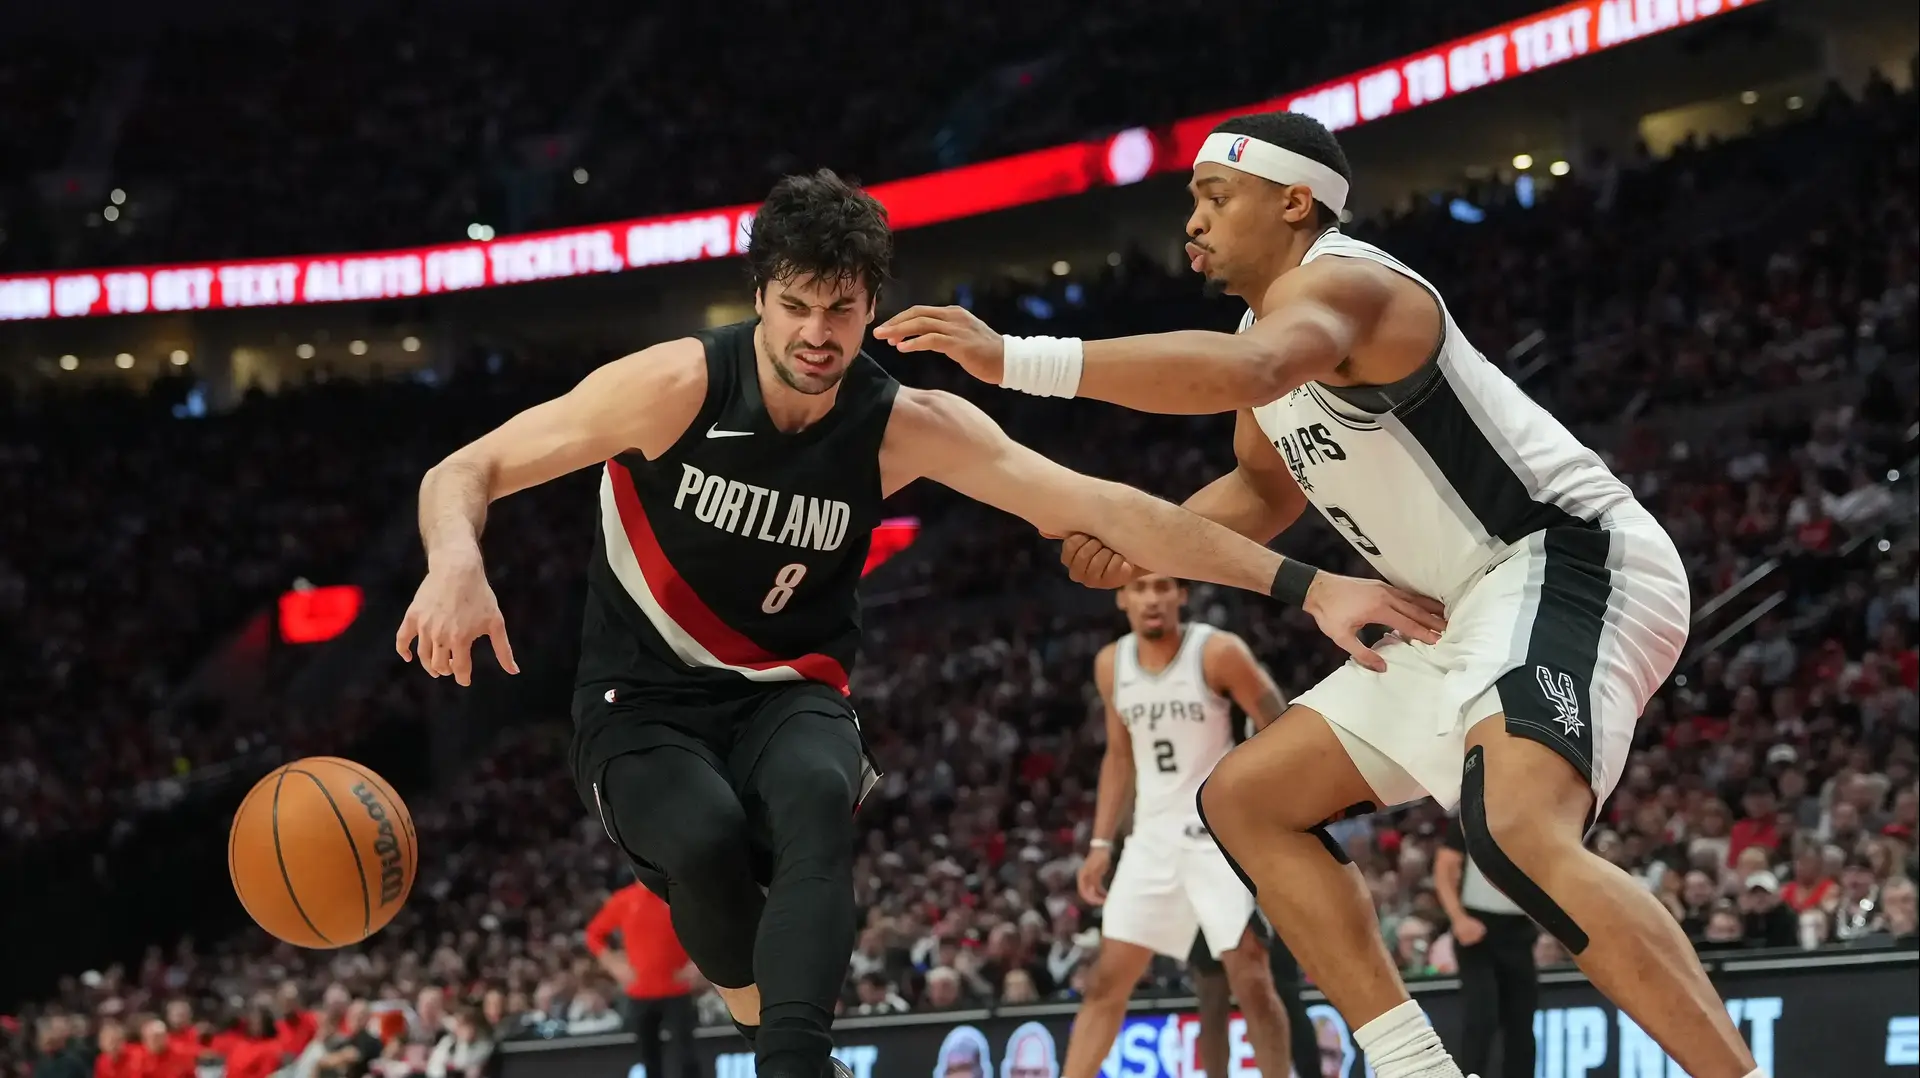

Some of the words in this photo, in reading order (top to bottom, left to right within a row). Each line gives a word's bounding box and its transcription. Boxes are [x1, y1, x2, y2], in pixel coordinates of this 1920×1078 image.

[1358, 69, 1400, 120] UP
[1403, 55, 1446, 105] TO
[1448, 34, 1507, 92] GET
[1510, 7, 1592, 71] TEXT
[0, 279, 51, 320] IGN
[54, 275, 100, 316] UP
[104, 273, 148, 313] TO
[151, 269, 213, 310] GET
[218, 263, 299, 306] TEXT
[304, 255, 423, 301] ALERTS
[425, 247, 486, 291] FOR
[627, 216, 731, 266] DROPS
[673, 462, 851, 551] PORTLAND
[1324, 504, 1383, 557] 3
[761, 563, 807, 614] 8
[1153, 738, 1178, 773] 2
[352, 783, 404, 908] Wilson
